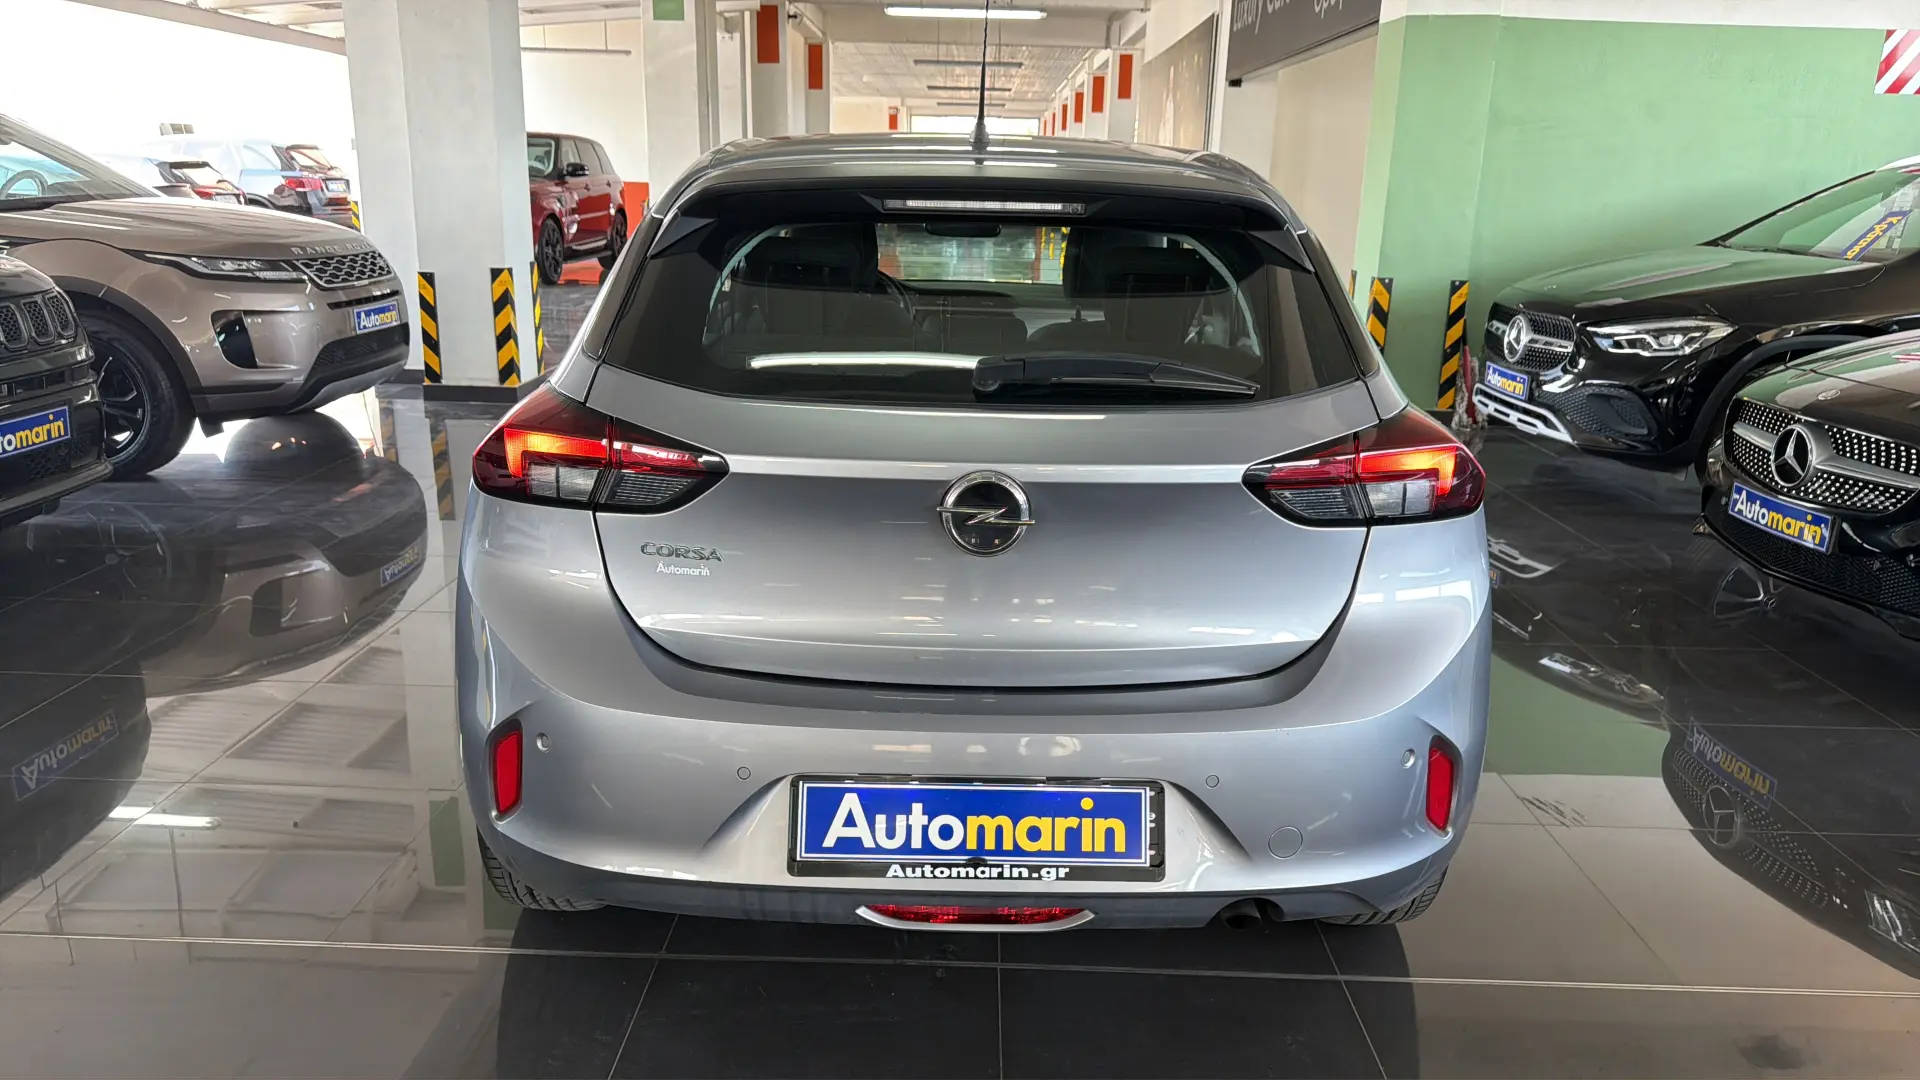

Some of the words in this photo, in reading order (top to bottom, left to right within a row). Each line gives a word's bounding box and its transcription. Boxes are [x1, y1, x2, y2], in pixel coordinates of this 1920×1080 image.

[290, 245, 342, 255] RANGE
[345, 242, 373, 251] ROVE
[360, 305, 397, 330] Automarin
[1487, 366, 1523, 396] Automarin
[0, 413, 64, 453] tomarin
[1735, 489, 1822, 545] Automarin
[640, 541, 724, 562] CORSA
[822, 792, 1126, 853] Automarin
[886, 863, 1069, 881] Automarin.gr
